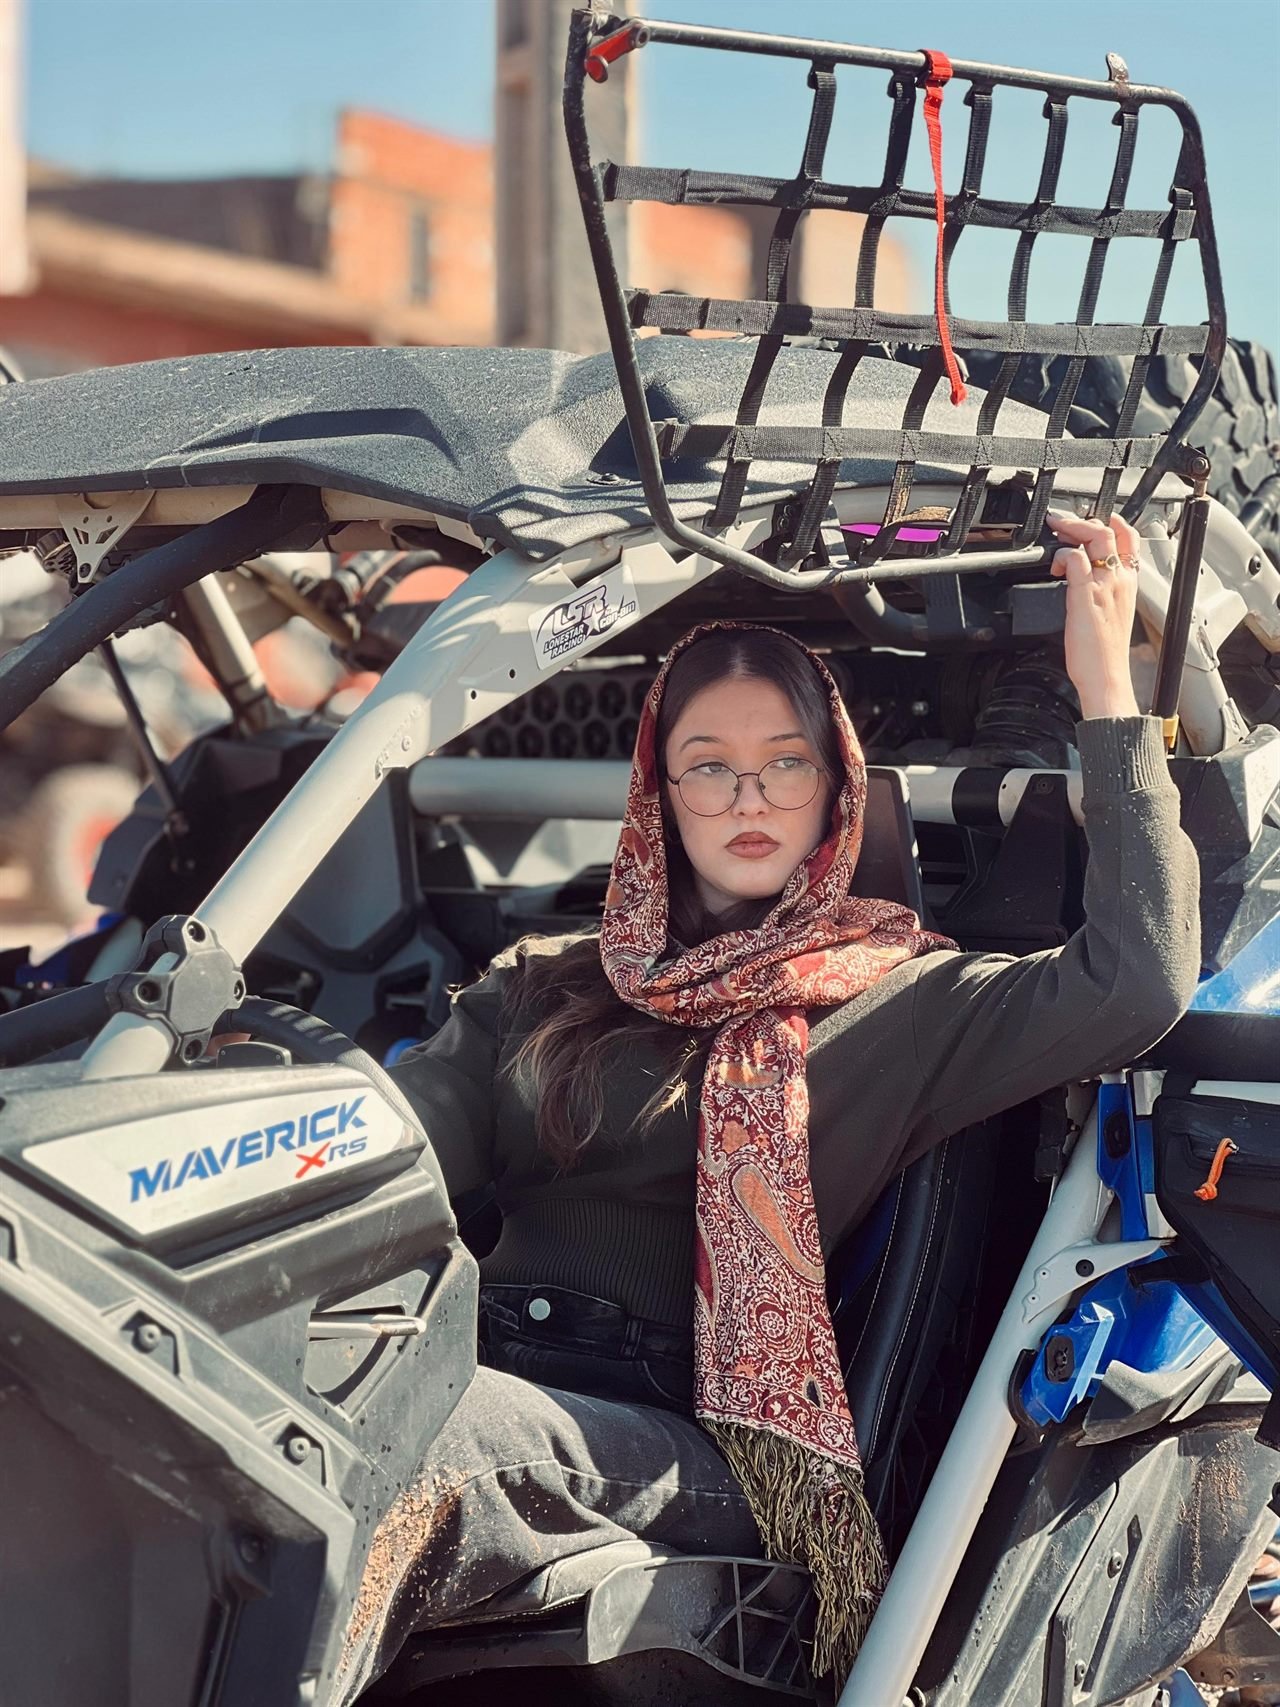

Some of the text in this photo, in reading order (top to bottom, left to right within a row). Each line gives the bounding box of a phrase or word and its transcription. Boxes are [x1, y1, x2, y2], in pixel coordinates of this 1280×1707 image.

[552, 585, 607, 635] LSR
[543, 624, 584, 653] LONESTAR
[551, 634, 585, 659] RACING
[128, 1096, 366, 1202] MAVERICK
